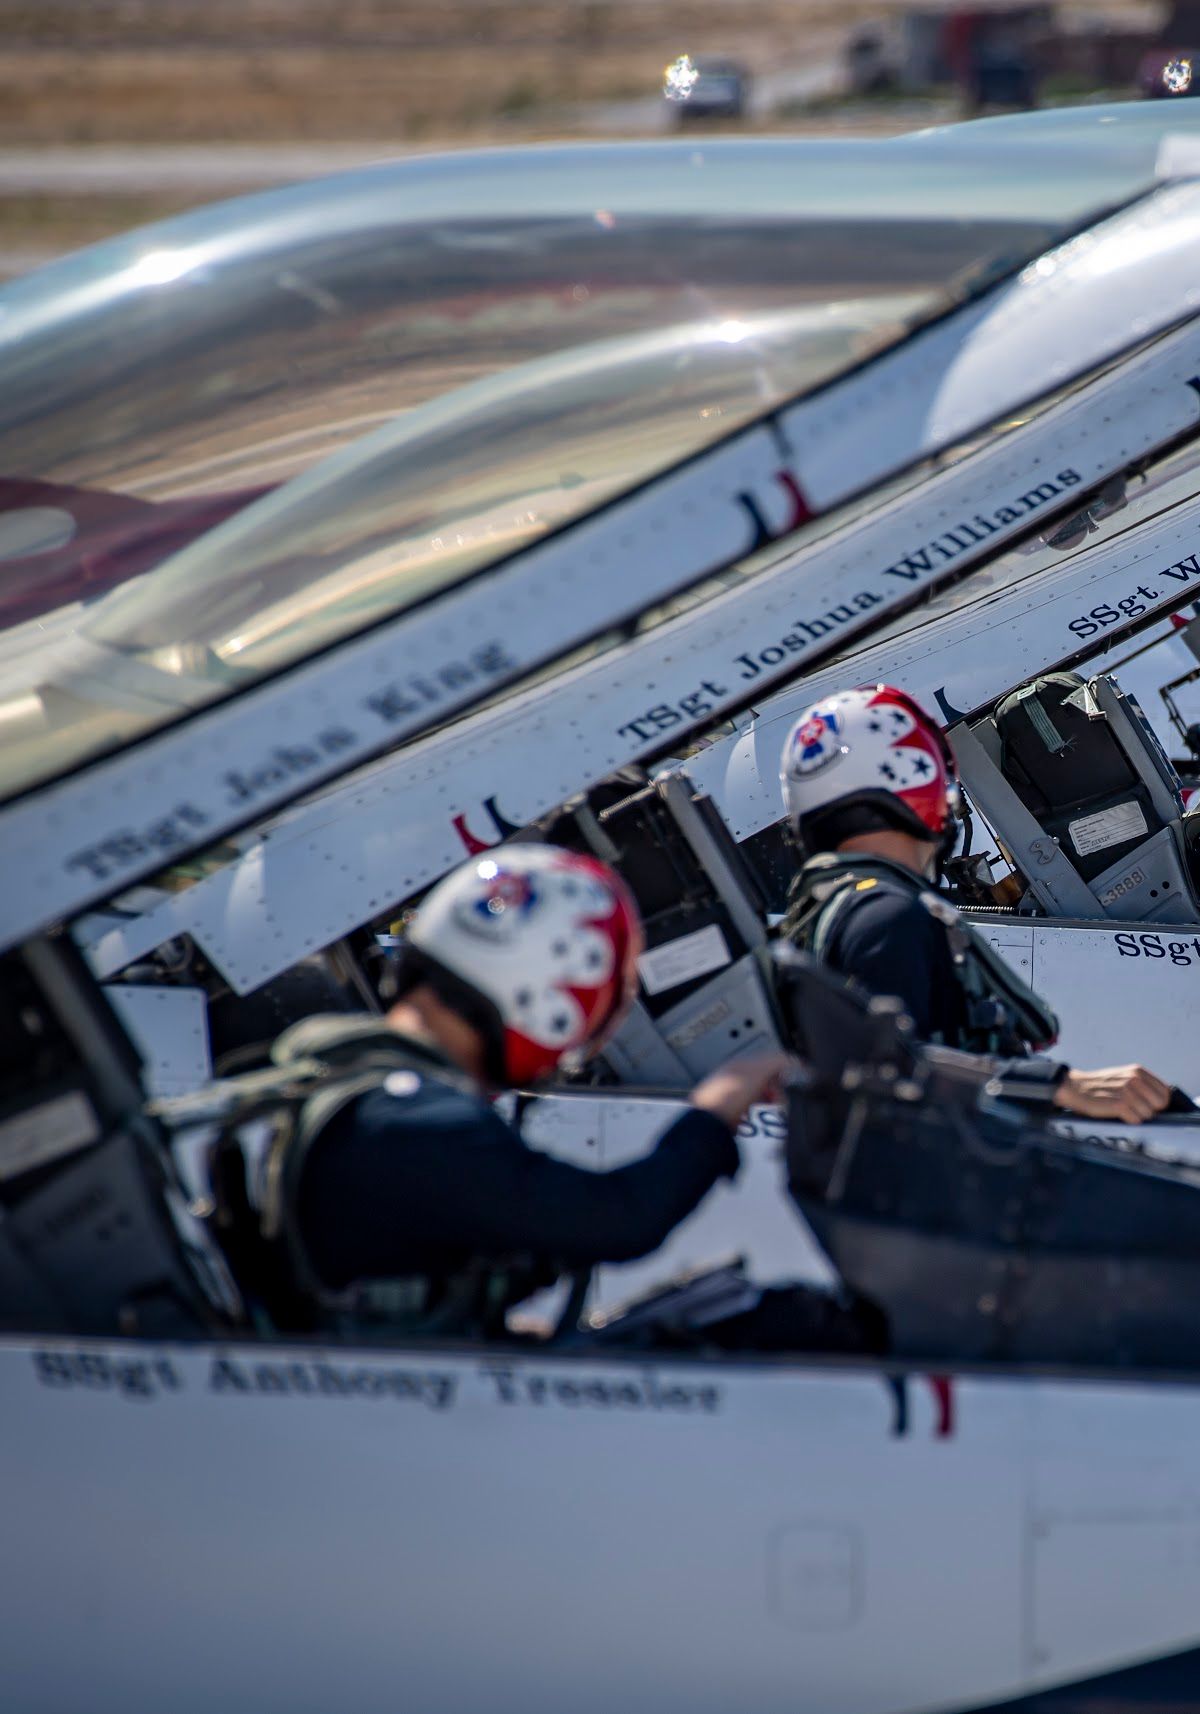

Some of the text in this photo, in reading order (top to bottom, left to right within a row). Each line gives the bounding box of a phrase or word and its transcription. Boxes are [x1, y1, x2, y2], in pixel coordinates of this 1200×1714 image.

[621, 466, 1083, 748] TSgt Joshua Williams
[1067, 581, 1161, 640] SSgt
[65, 642, 514, 882] TSgt John King
[33, 1350, 182, 1401] SSgt
[209, 1352, 458, 1411] Anthony
